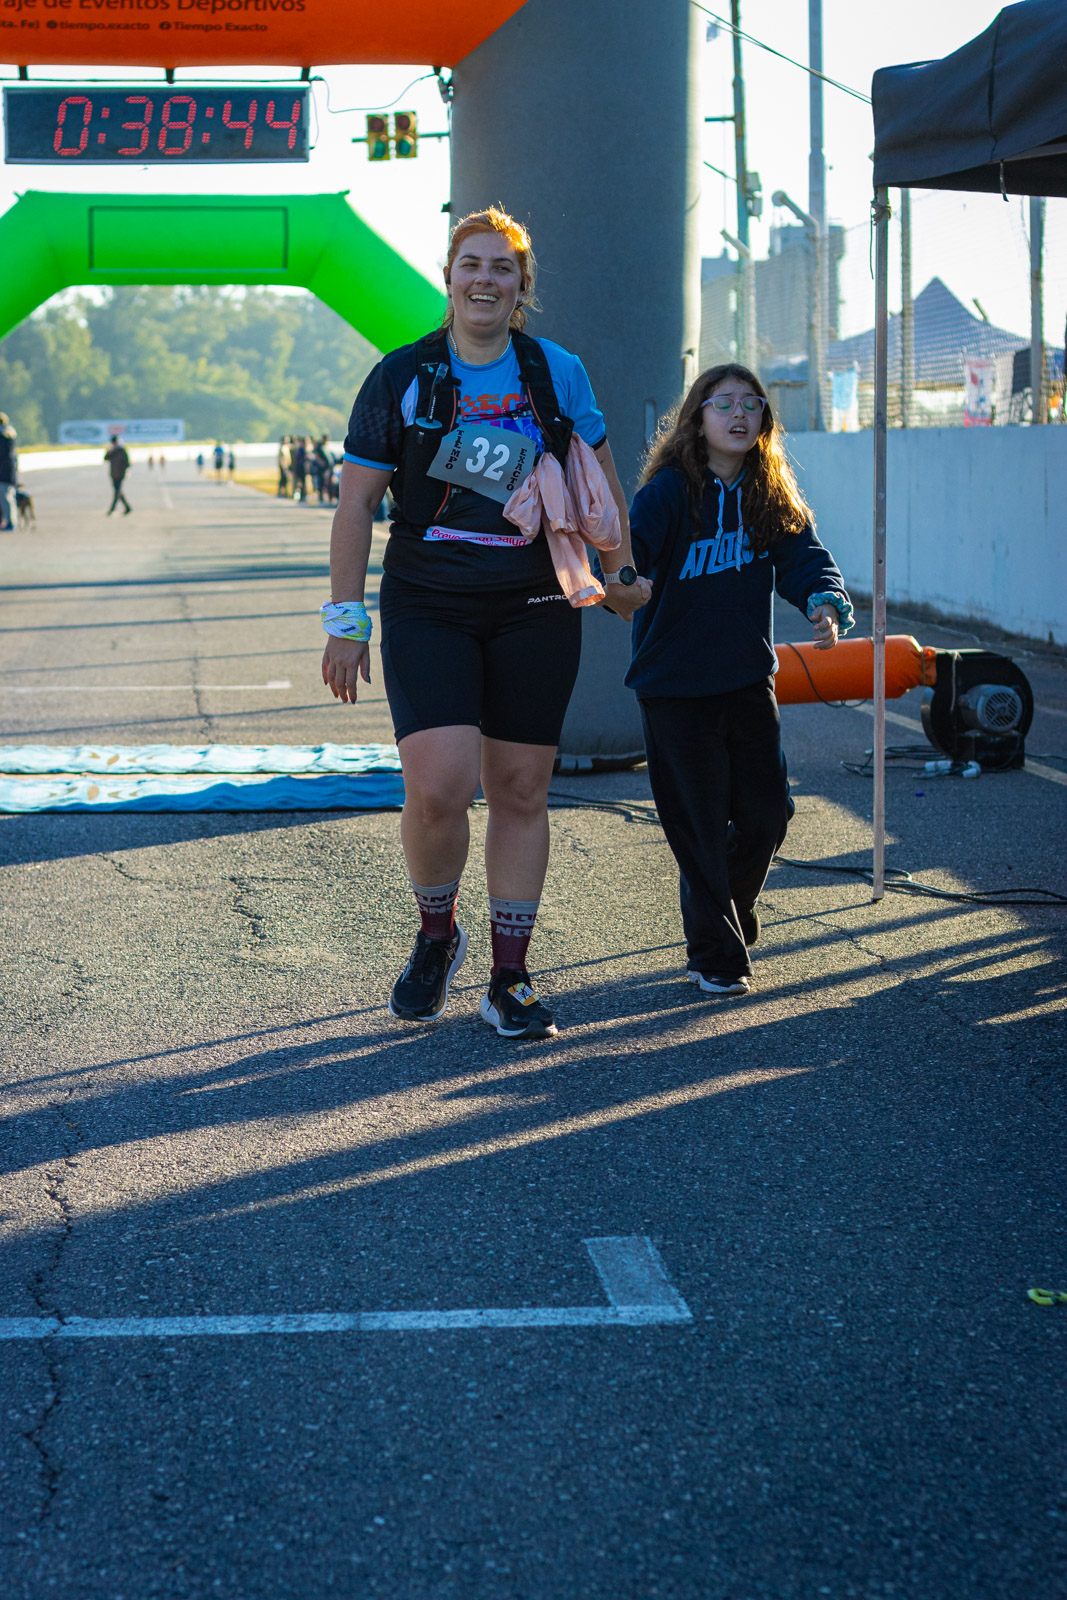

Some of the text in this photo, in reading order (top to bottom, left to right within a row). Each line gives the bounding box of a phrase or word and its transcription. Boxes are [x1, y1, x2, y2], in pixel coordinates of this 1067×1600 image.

[0, 0, 306, 14] aje de Eventos Deportivos
[0, 20, 18, 29] ta.
[173, 21, 222, 32] Tiempo
[224, 22, 269, 32] Exacto
[53, 96, 300, 156] 0:38:44
[445, 429, 465, 470] TIEMPO
[465, 436, 510, 482] 32
[506, 447, 528, 491] EXACTO
